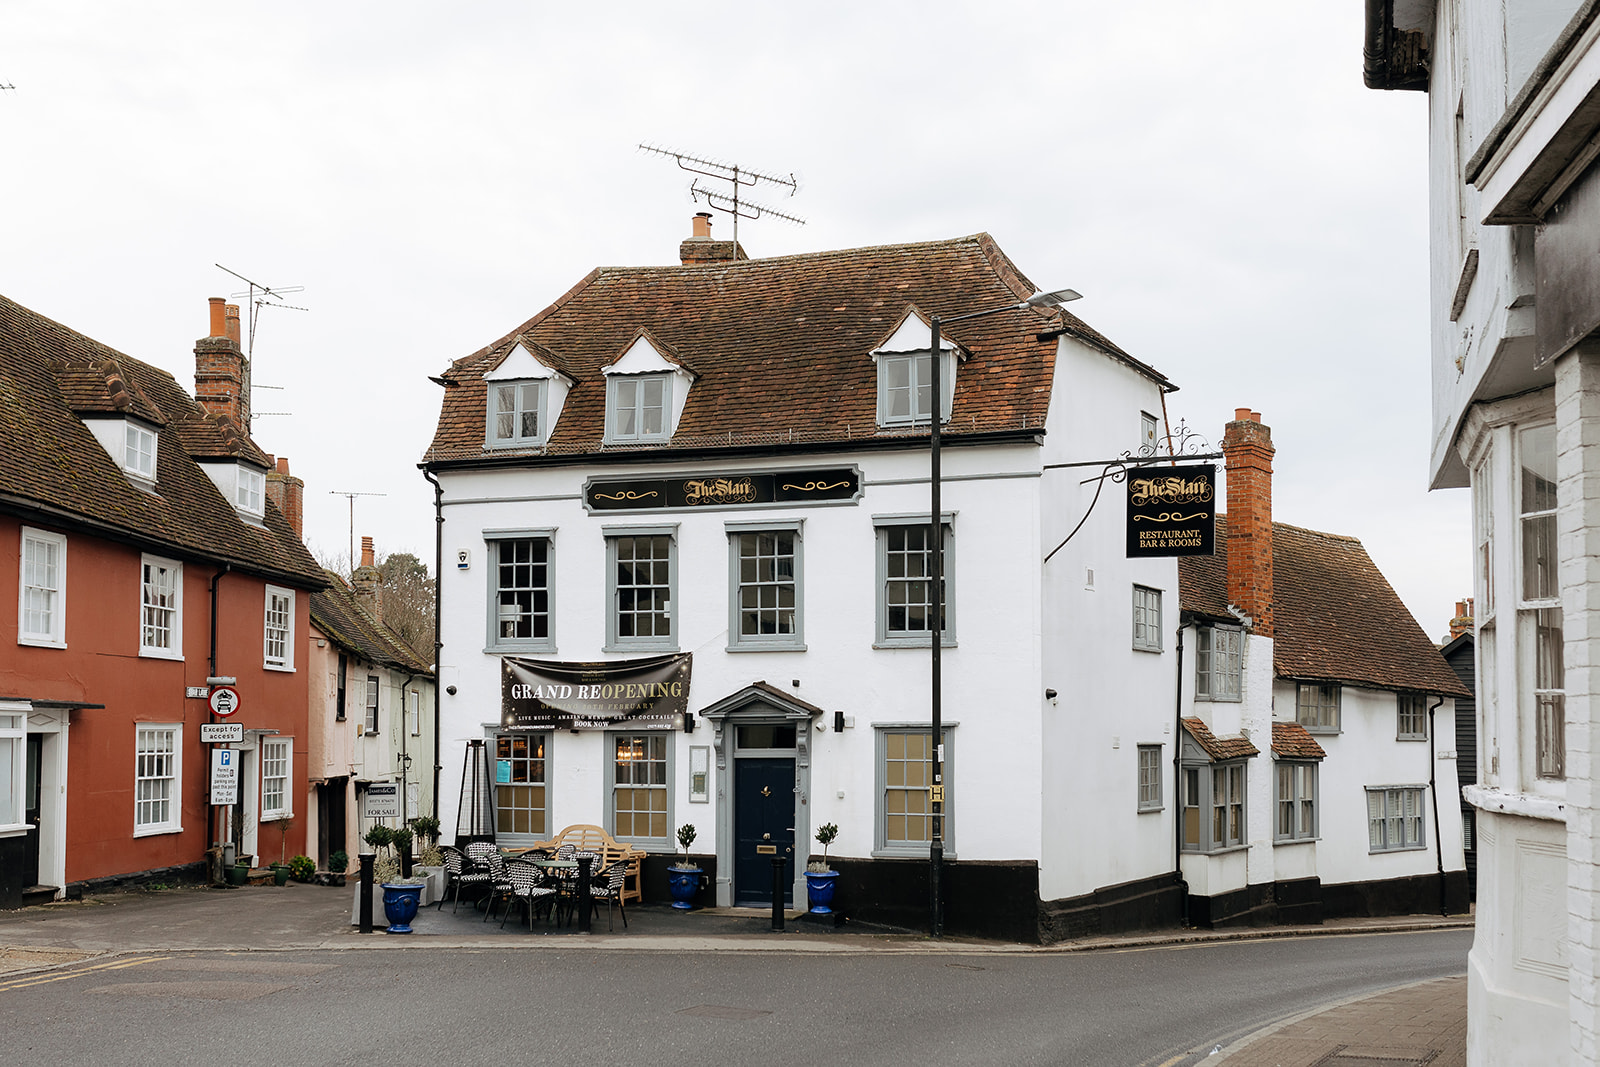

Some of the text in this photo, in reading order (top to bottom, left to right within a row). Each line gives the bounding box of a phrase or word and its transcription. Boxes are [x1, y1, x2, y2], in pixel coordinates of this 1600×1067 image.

[1139, 529, 1202, 539] RESTAURANT,
[1139, 540, 1158, 548] BAR
[1168, 538, 1202, 547] ROOMS
[511, 681, 683, 700] GRAND REOPENING
[607, 702, 655, 710] FEBRUARY
[573, 720, 610, 728] BOOK NOW
[222, 752, 230, 764] P
